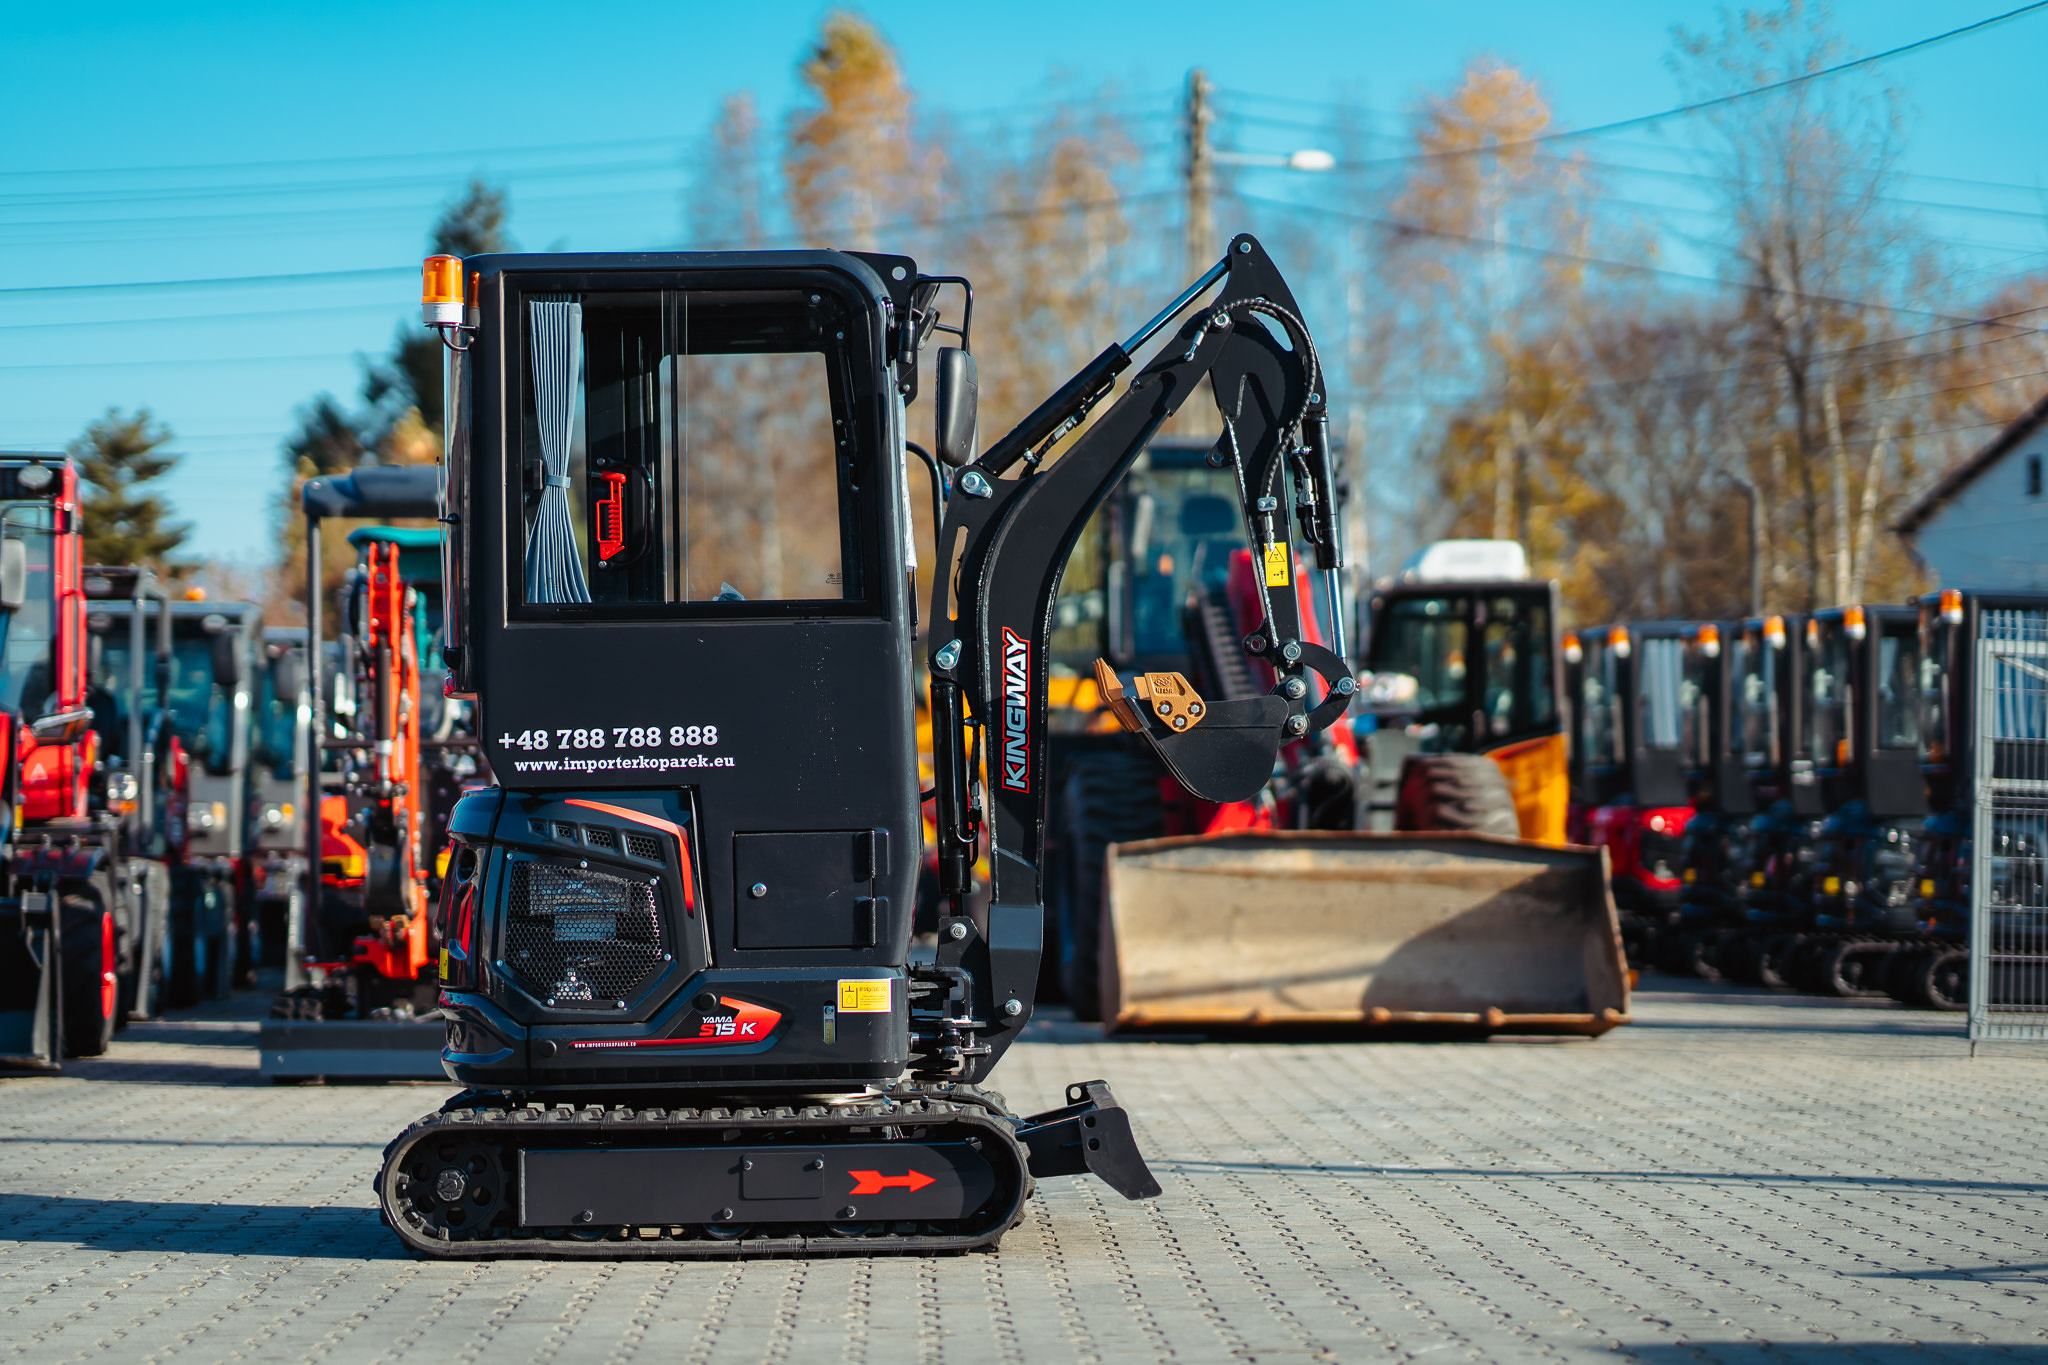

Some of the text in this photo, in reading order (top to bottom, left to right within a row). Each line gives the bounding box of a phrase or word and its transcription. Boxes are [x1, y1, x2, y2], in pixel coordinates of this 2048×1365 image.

[1004, 630, 1028, 790] KINGWAY
[498, 725, 719, 751] +48 788 788 888
[514, 754, 736, 773] www.importerkoparek.eu
[699, 1022, 758, 1037] S15 K
